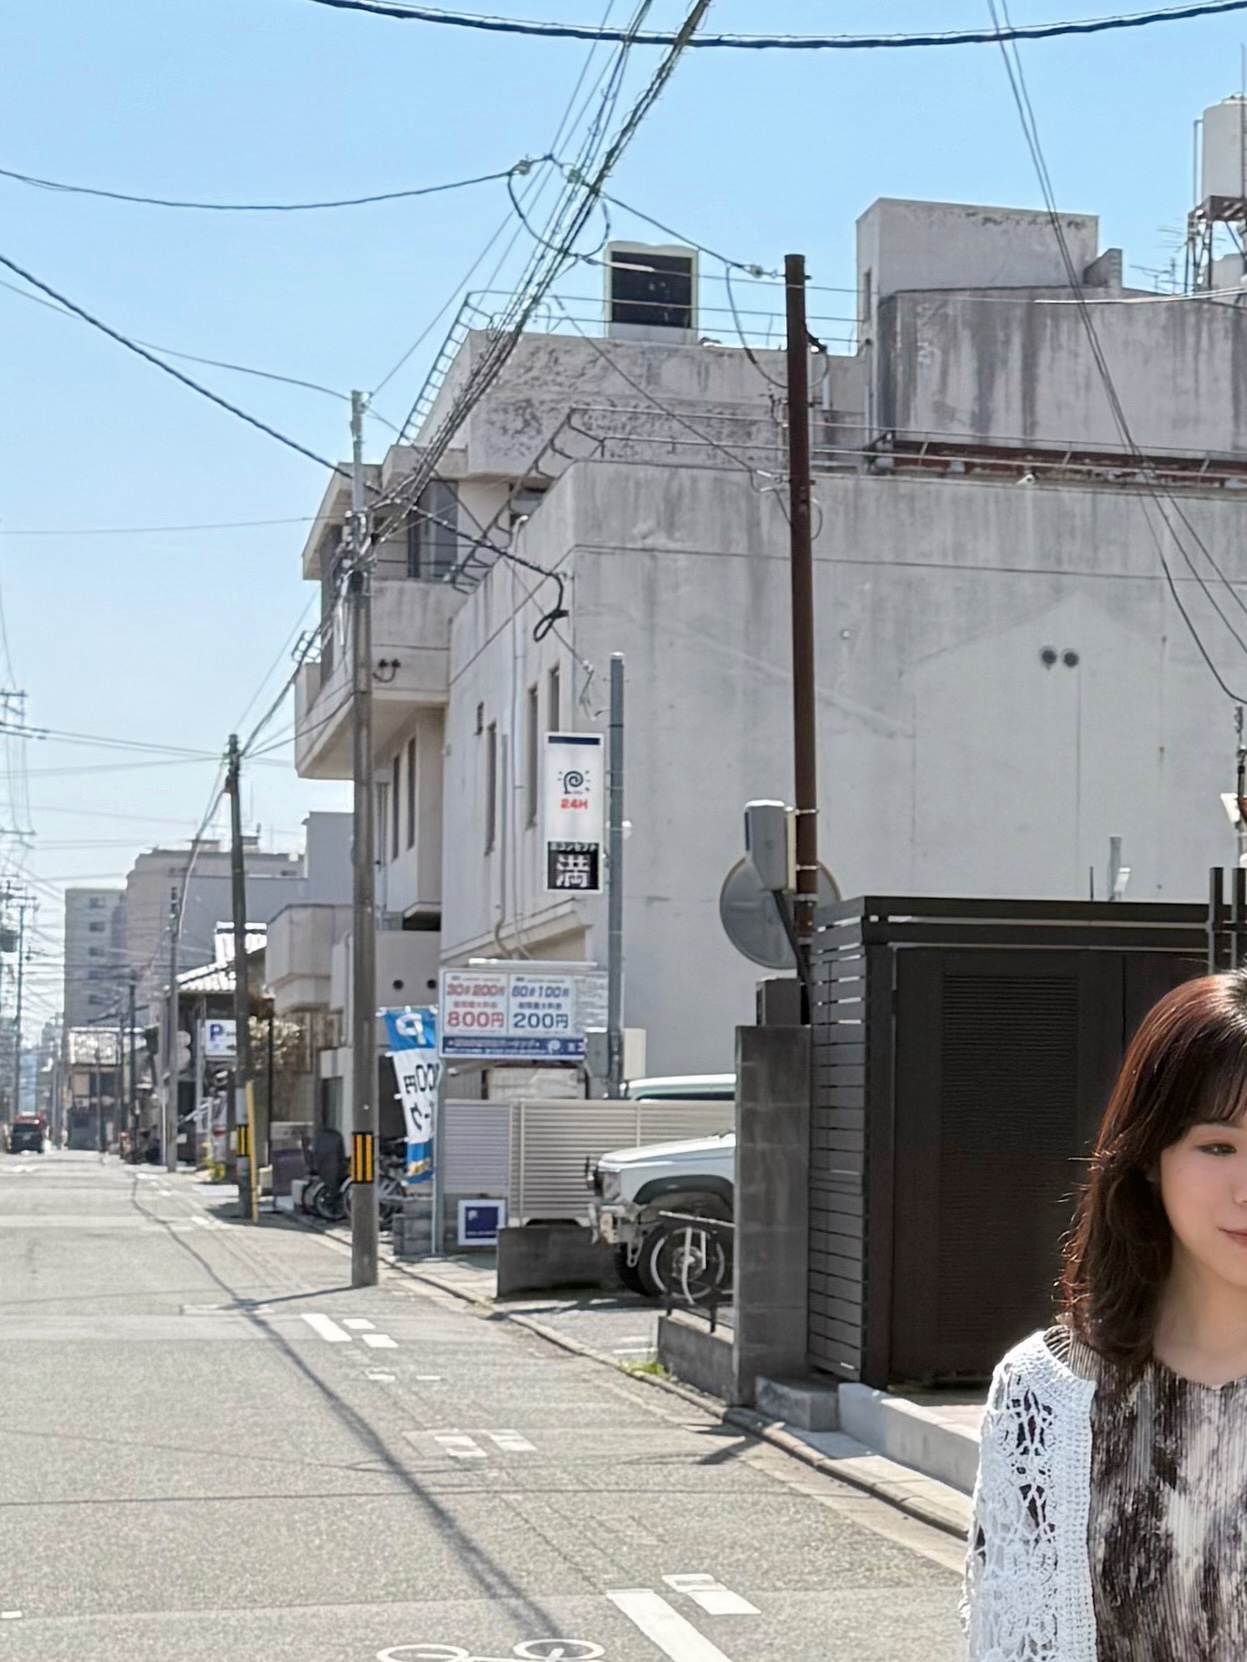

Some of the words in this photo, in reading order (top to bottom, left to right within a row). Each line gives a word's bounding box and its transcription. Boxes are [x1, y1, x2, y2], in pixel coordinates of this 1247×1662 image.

[560, 798, 588, 810] 24H
[556, 854, 591, 888] 満
[447, 1011, 504, 1028] 800円
[513, 1012, 569, 1029] 200円
[210, 1024, 224, 1041] P
